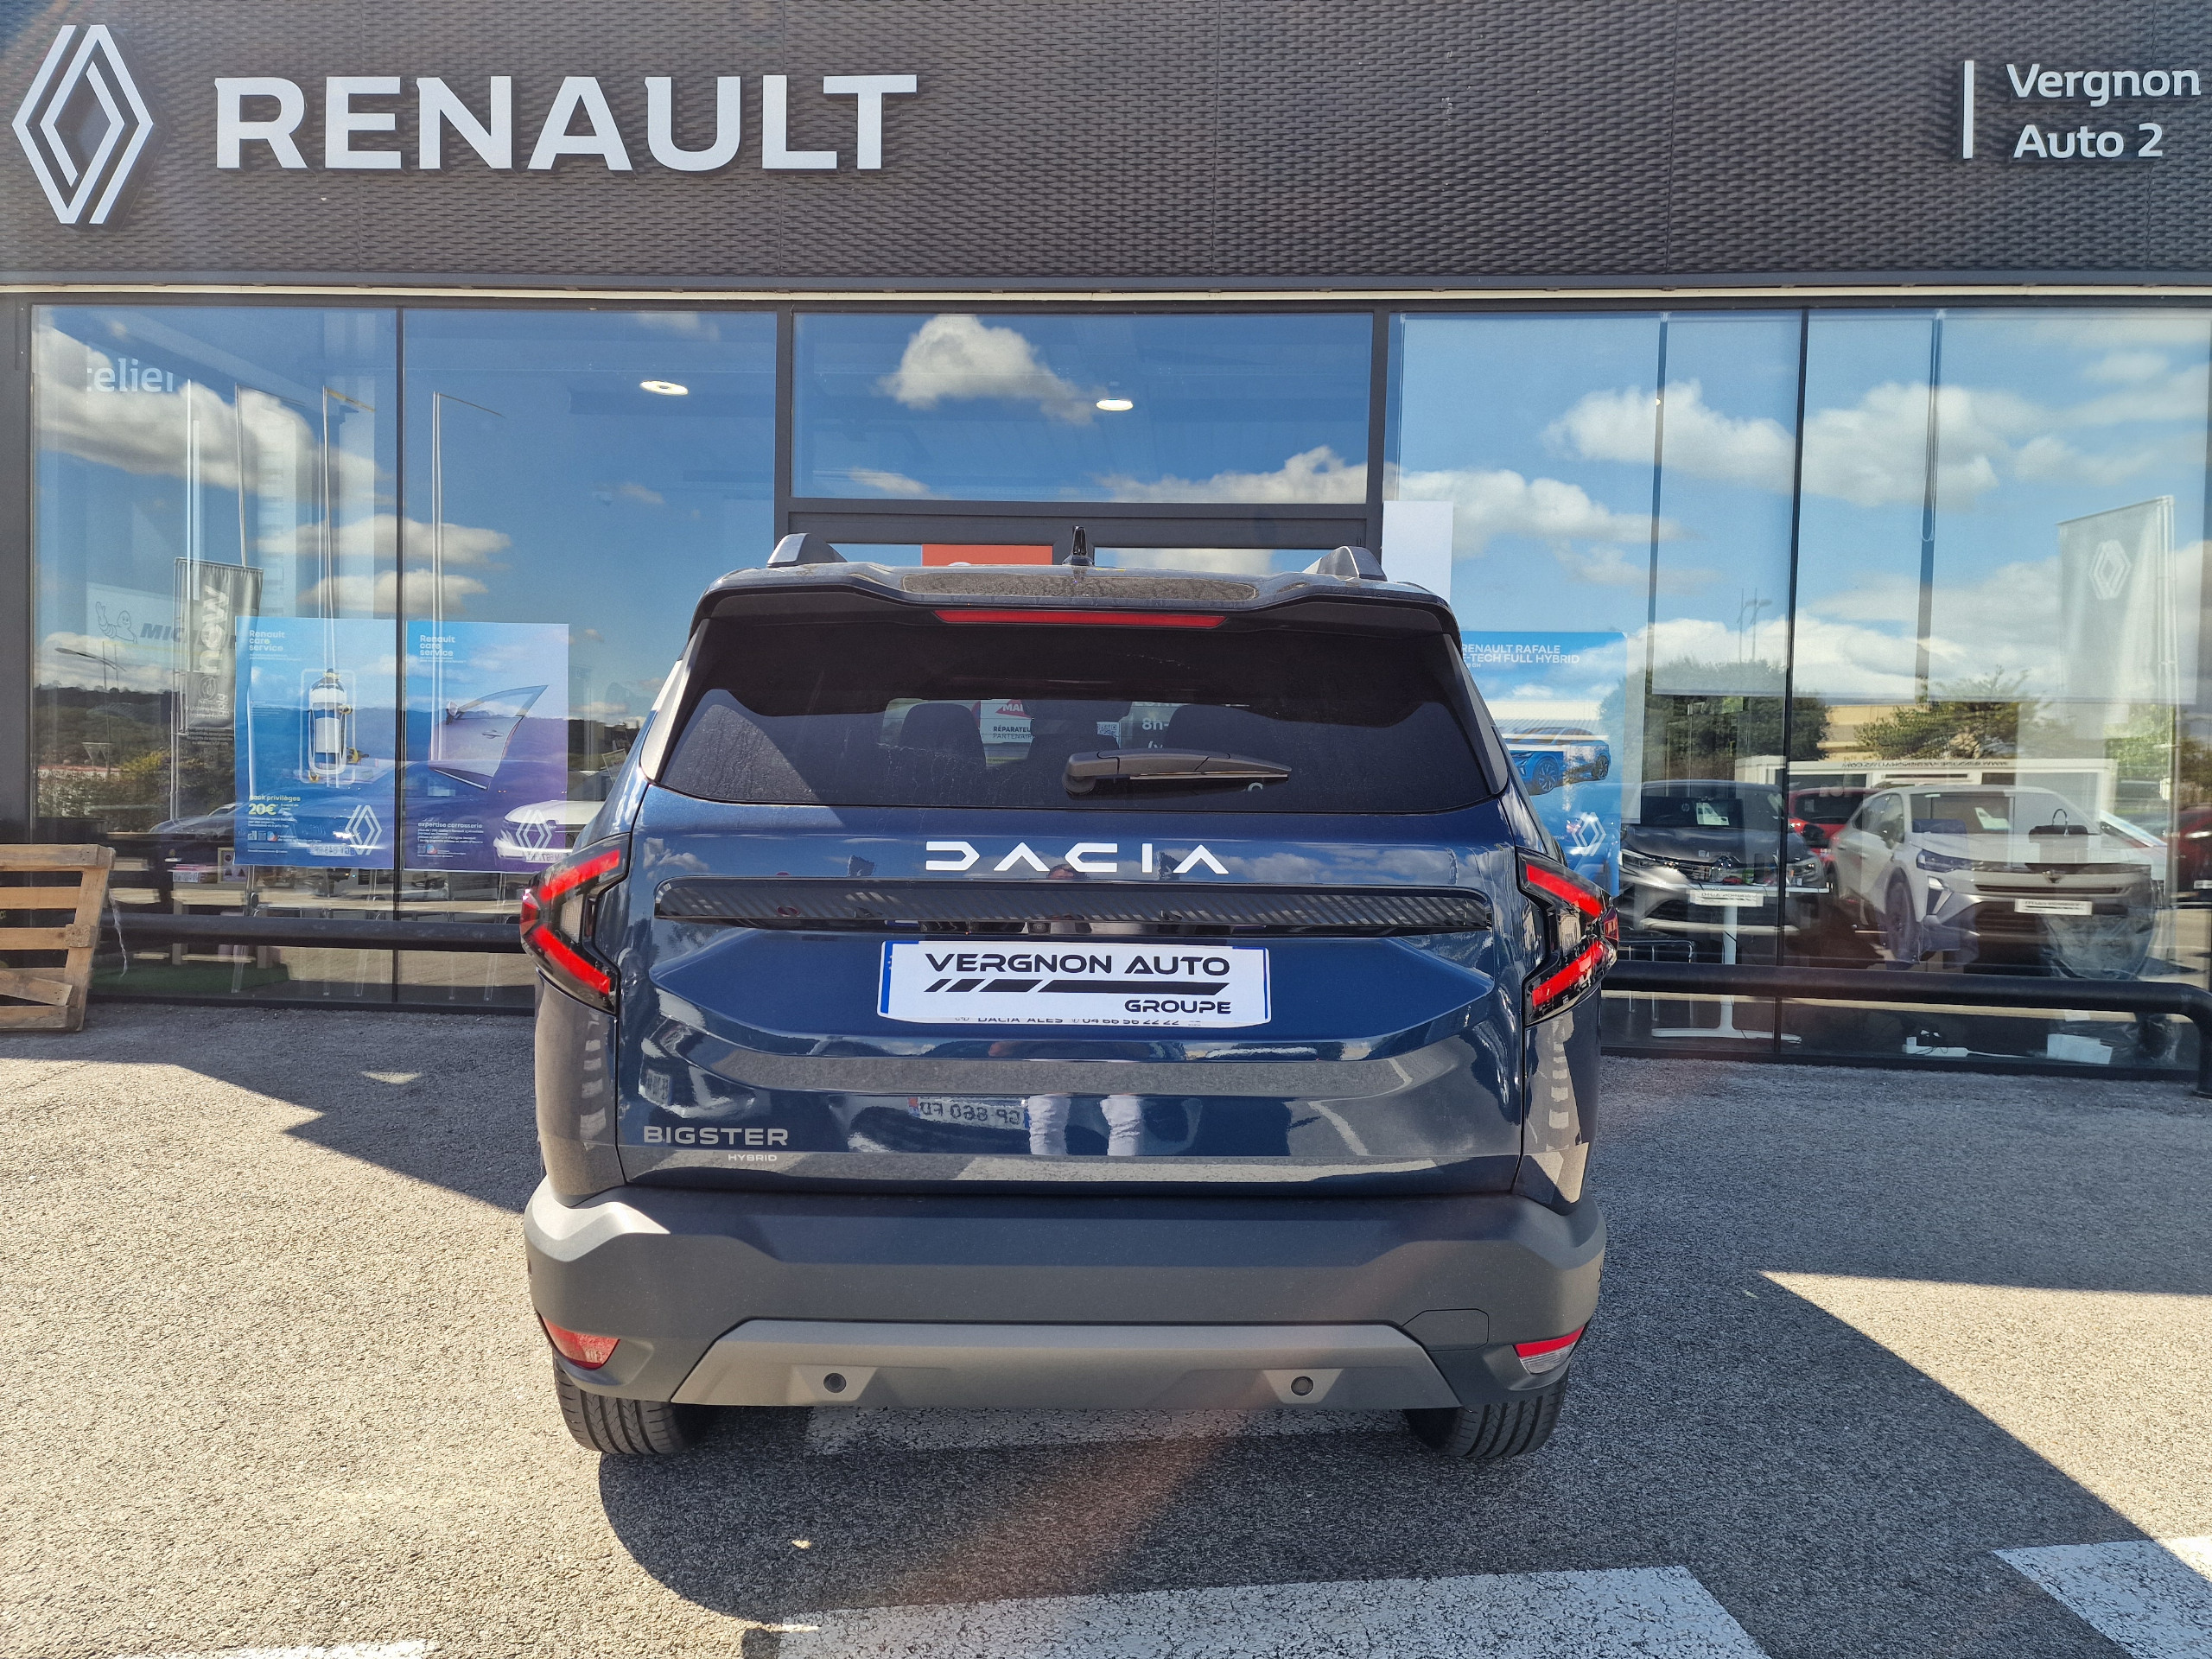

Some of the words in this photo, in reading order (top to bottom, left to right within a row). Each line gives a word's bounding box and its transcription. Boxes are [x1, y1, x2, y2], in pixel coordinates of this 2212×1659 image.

[2005, 63, 2202, 107] Vergnon
[214, 74, 918, 171] RENAULT
[2012, 124, 2125, 159] Auto
[2138, 122, 2164, 158] 2
[249, 630, 286, 639] Renault
[1462, 644, 1513, 653] RENAULT
[1515, 645, 1561, 654] RAFALE
[1503, 654, 1534, 664] FULL
[1535, 654, 1580, 664] HYBRID
[993, 724, 1032, 733] RÉPARATEU
[266, 794, 302, 803] privilèges
[926, 841, 1230, 874] DACIA
[925, 953, 1112, 974] VERGNON
[1123, 955, 1230, 976] AUTO
[1124, 999, 1232, 1014] GROUPE
[643, 1125, 789, 1147] BIGSTER
[728, 1154, 778, 1162] HYBRID
